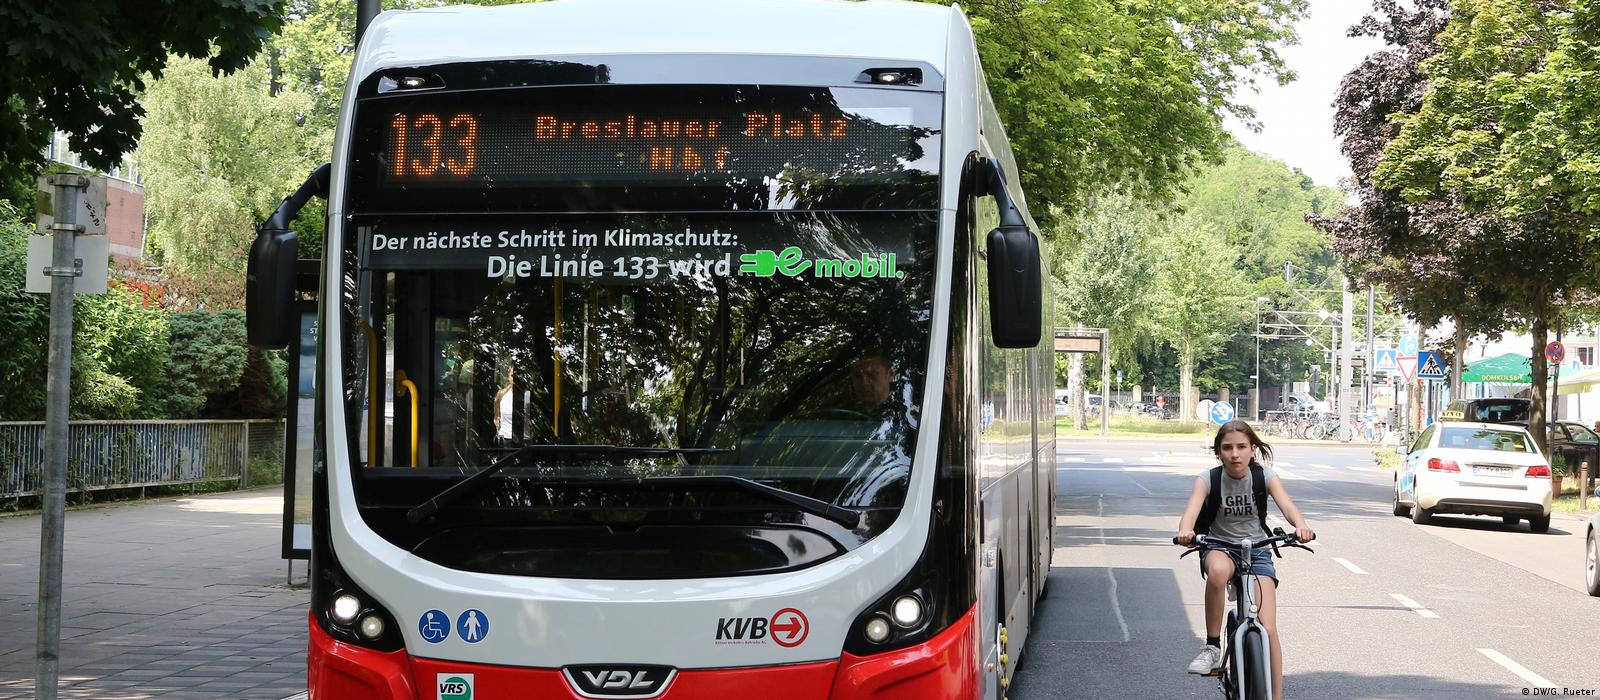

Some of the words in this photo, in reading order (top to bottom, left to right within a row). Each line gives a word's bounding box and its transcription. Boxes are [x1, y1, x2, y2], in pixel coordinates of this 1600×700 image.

[536, 114, 721, 139] Breslauer
[747, 113, 847, 138] Platz
[393, 113, 476, 176] 133
[651, 146, 729, 170] Hbf
[372, 234, 407, 251] Der
[413, 232, 492, 249] nächste
[498, 230, 565, 248] Schritt
[572, 229, 598, 247] im
[604, 228, 738, 247] Klimaschutz:
[487, 255, 532, 278] Die
[540, 254, 603, 277] Linie
[613, 257, 659, 280] 133
[669, 253, 731, 277] wird
[815, 253, 905, 278] mobil.
[1224, 506, 1253, 517] PWR
[1225, 495, 1251, 507] GRL
[715, 618, 768, 640] KVB
[440, 683, 464, 694] VRS
[581, 670, 655, 689] VDL
